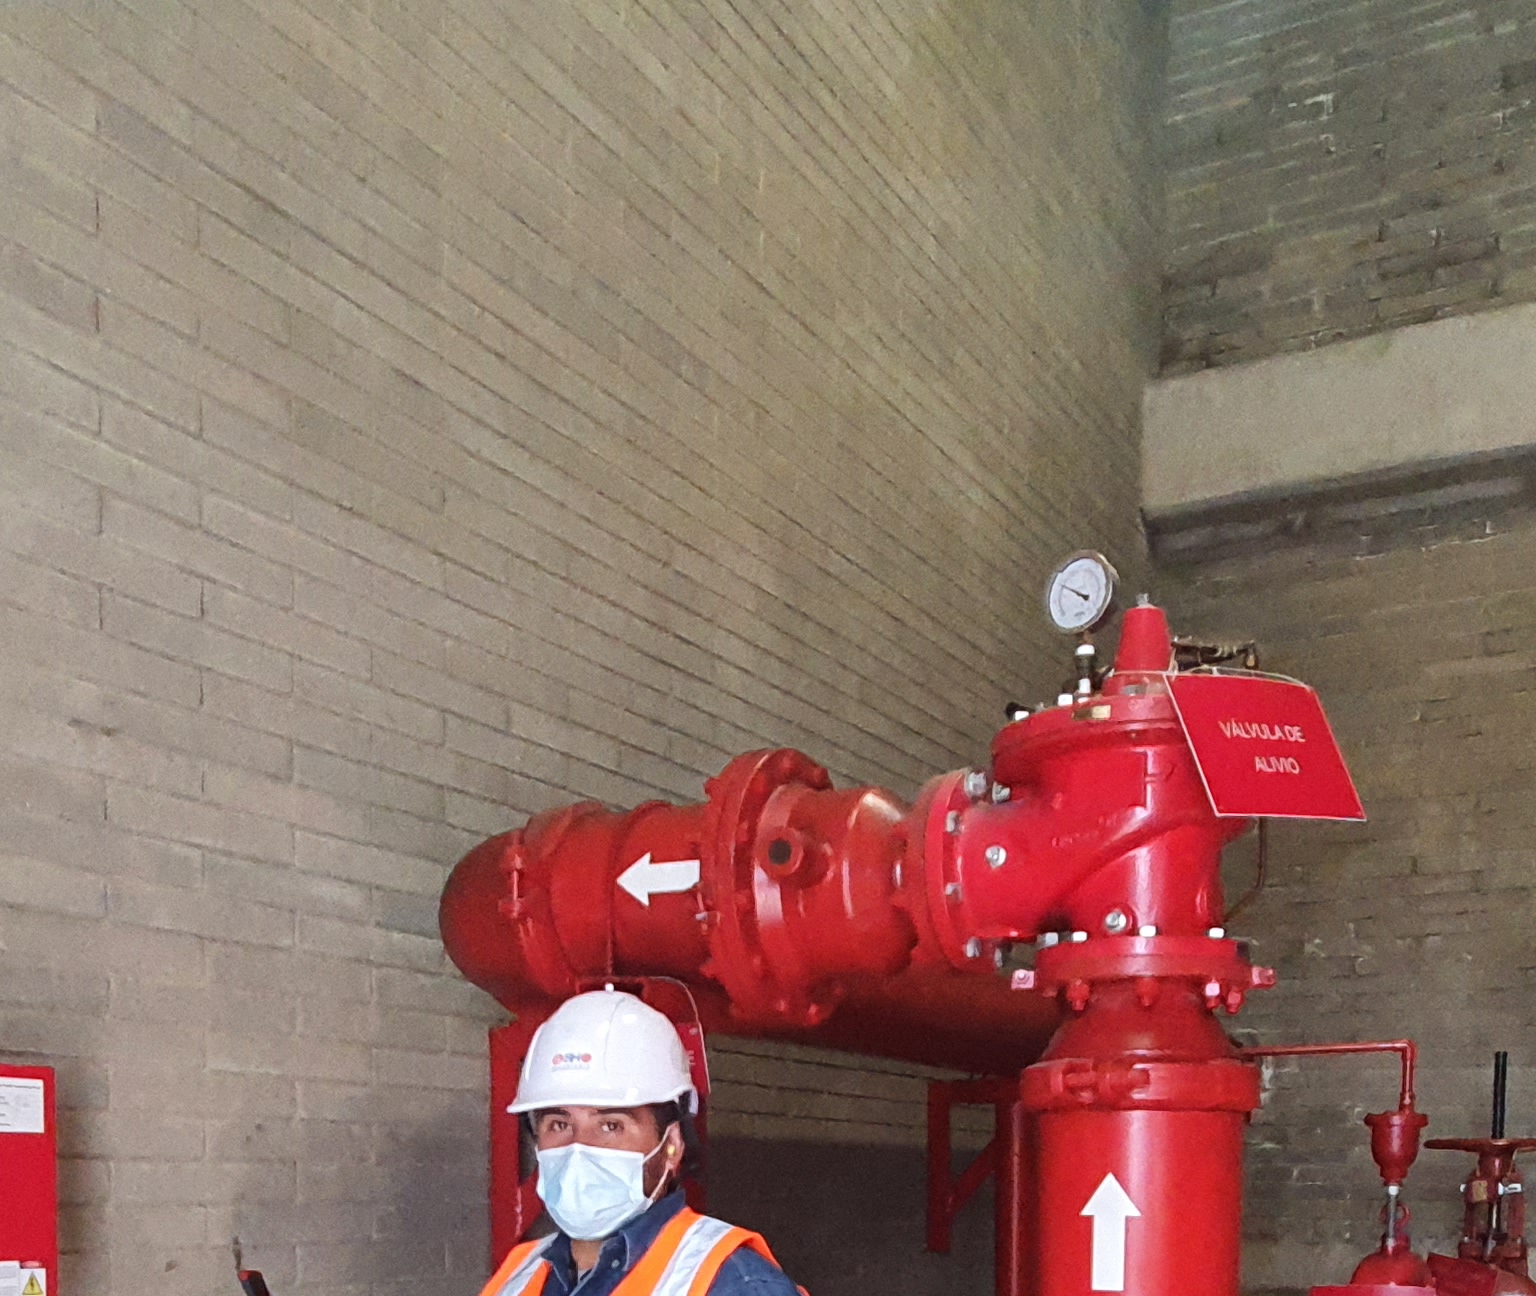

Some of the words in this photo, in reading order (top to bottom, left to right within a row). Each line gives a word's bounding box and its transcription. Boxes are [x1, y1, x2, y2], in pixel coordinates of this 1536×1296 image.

[1218, 718, 1284, 740] VÁLVULA
[1285, 725, 1306, 742] DE
[1254, 756, 1301, 774] ALIVIO
